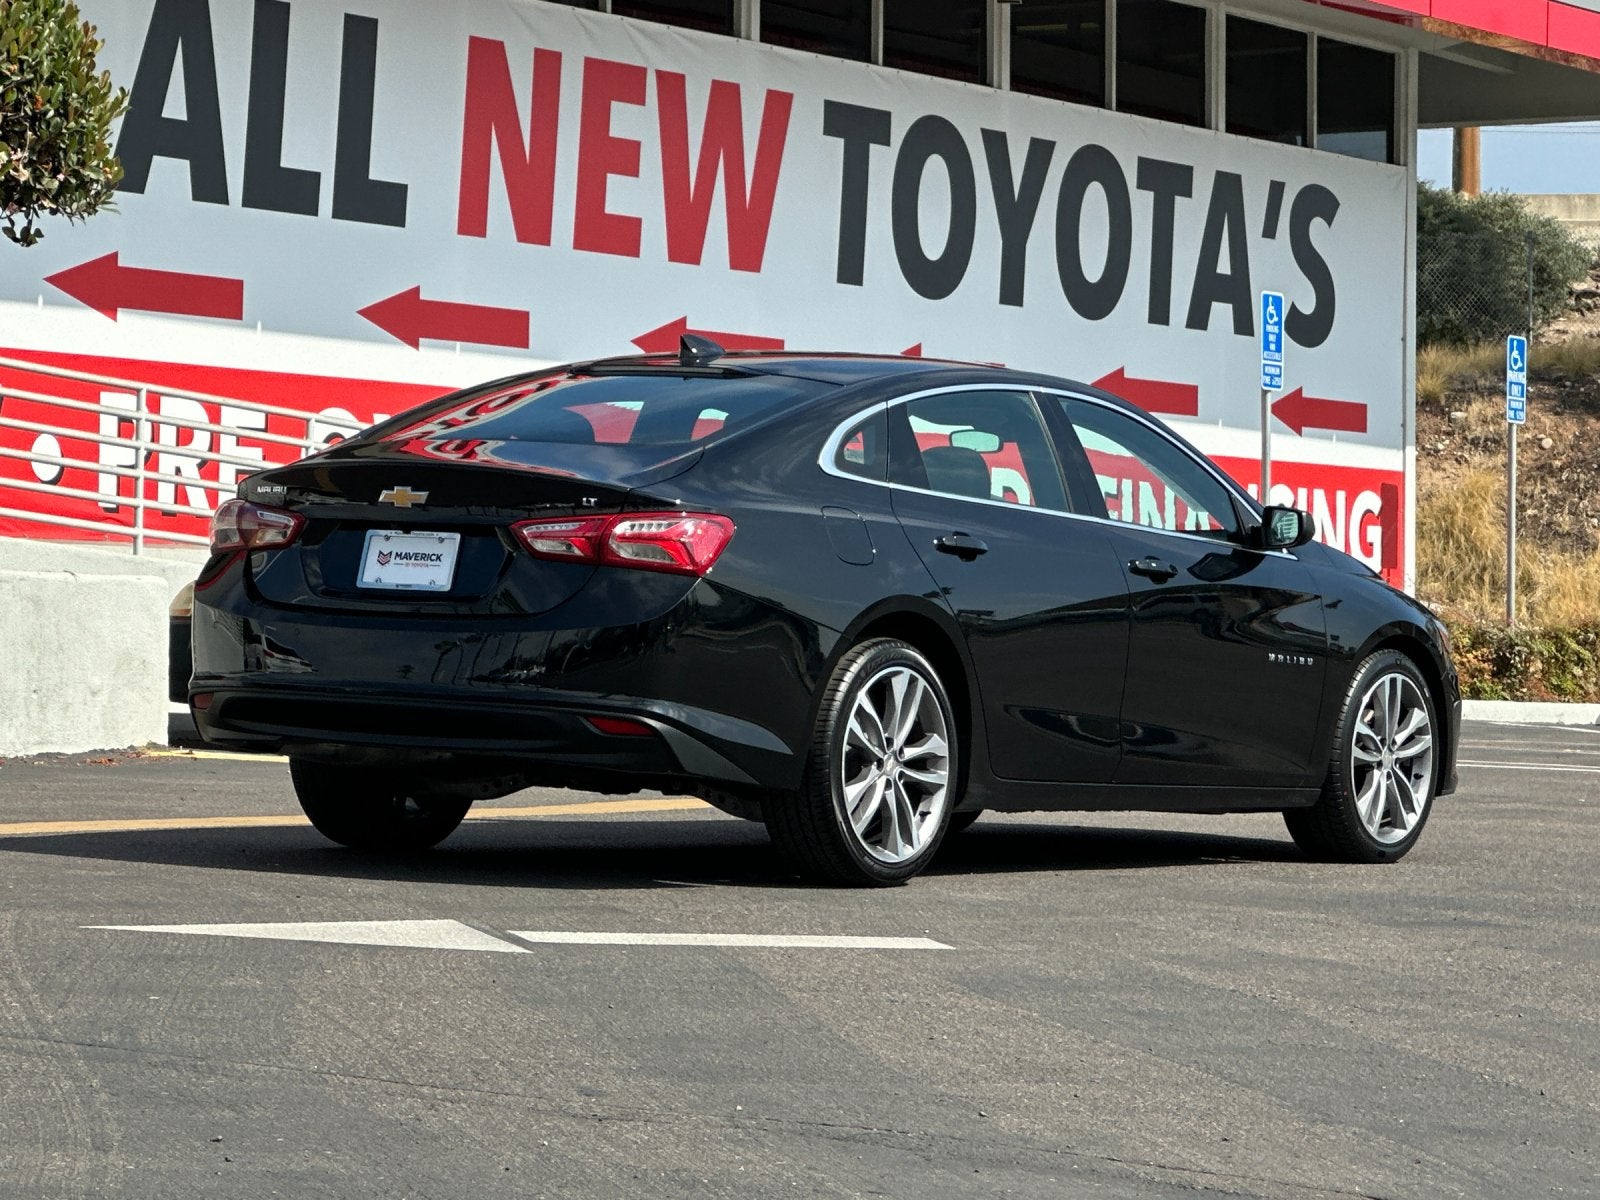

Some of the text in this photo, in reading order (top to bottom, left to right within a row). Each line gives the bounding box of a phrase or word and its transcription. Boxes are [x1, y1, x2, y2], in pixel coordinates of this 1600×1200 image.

[117, 0, 1341, 348] ALL NEW TOYOTA'S
[98, 391, 268, 517] PRE
[582, 497, 598, 507] LT
[394, 551, 443, 562] MAVERICK
[1268, 653, 1314, 666] MALIBU
